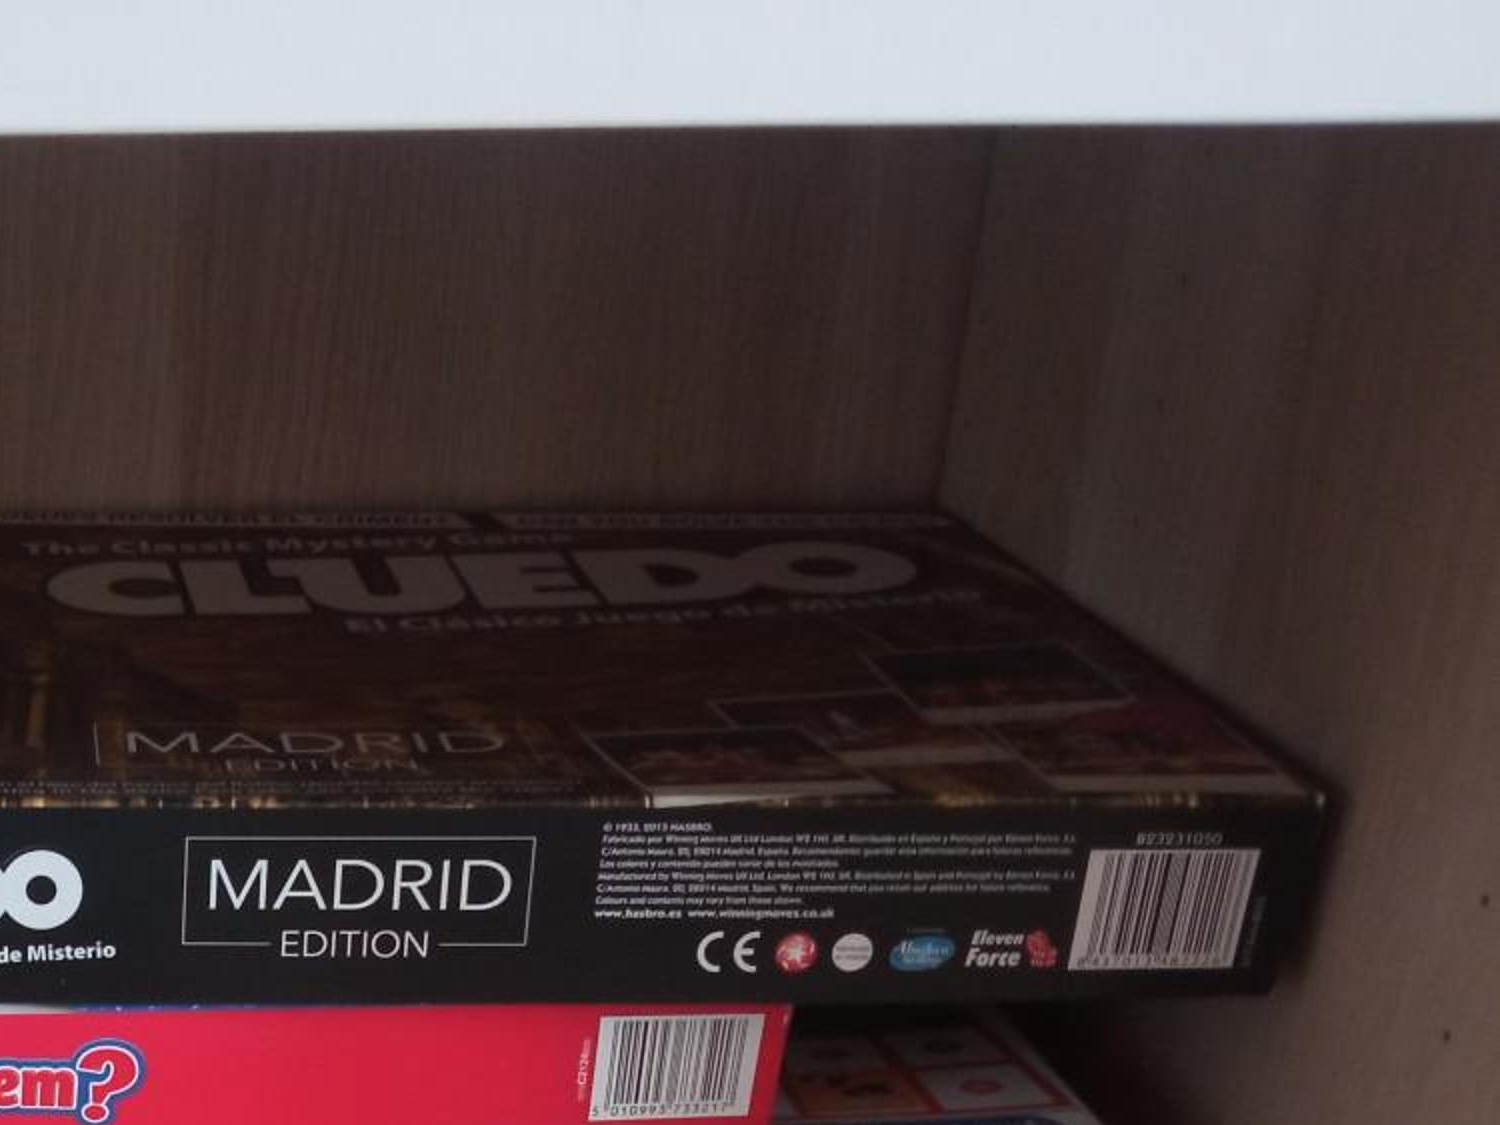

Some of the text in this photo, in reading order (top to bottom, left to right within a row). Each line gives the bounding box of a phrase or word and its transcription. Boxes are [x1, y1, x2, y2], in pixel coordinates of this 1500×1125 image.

[265, 535, 437, 554] Mystery
[45, 541, 917, 616] CLUEDO
[126, 731, 505, 753] MADRID
[222, 757, 422, 772] EDITION
[208, 858, 514, 912] MADRID
[279, 929, 430, 959] EDITION
[971, 930, 1026, 946] Eleven
[27, 940, 117, 963] Misterio
[963, 947, 1022, 968] Force
